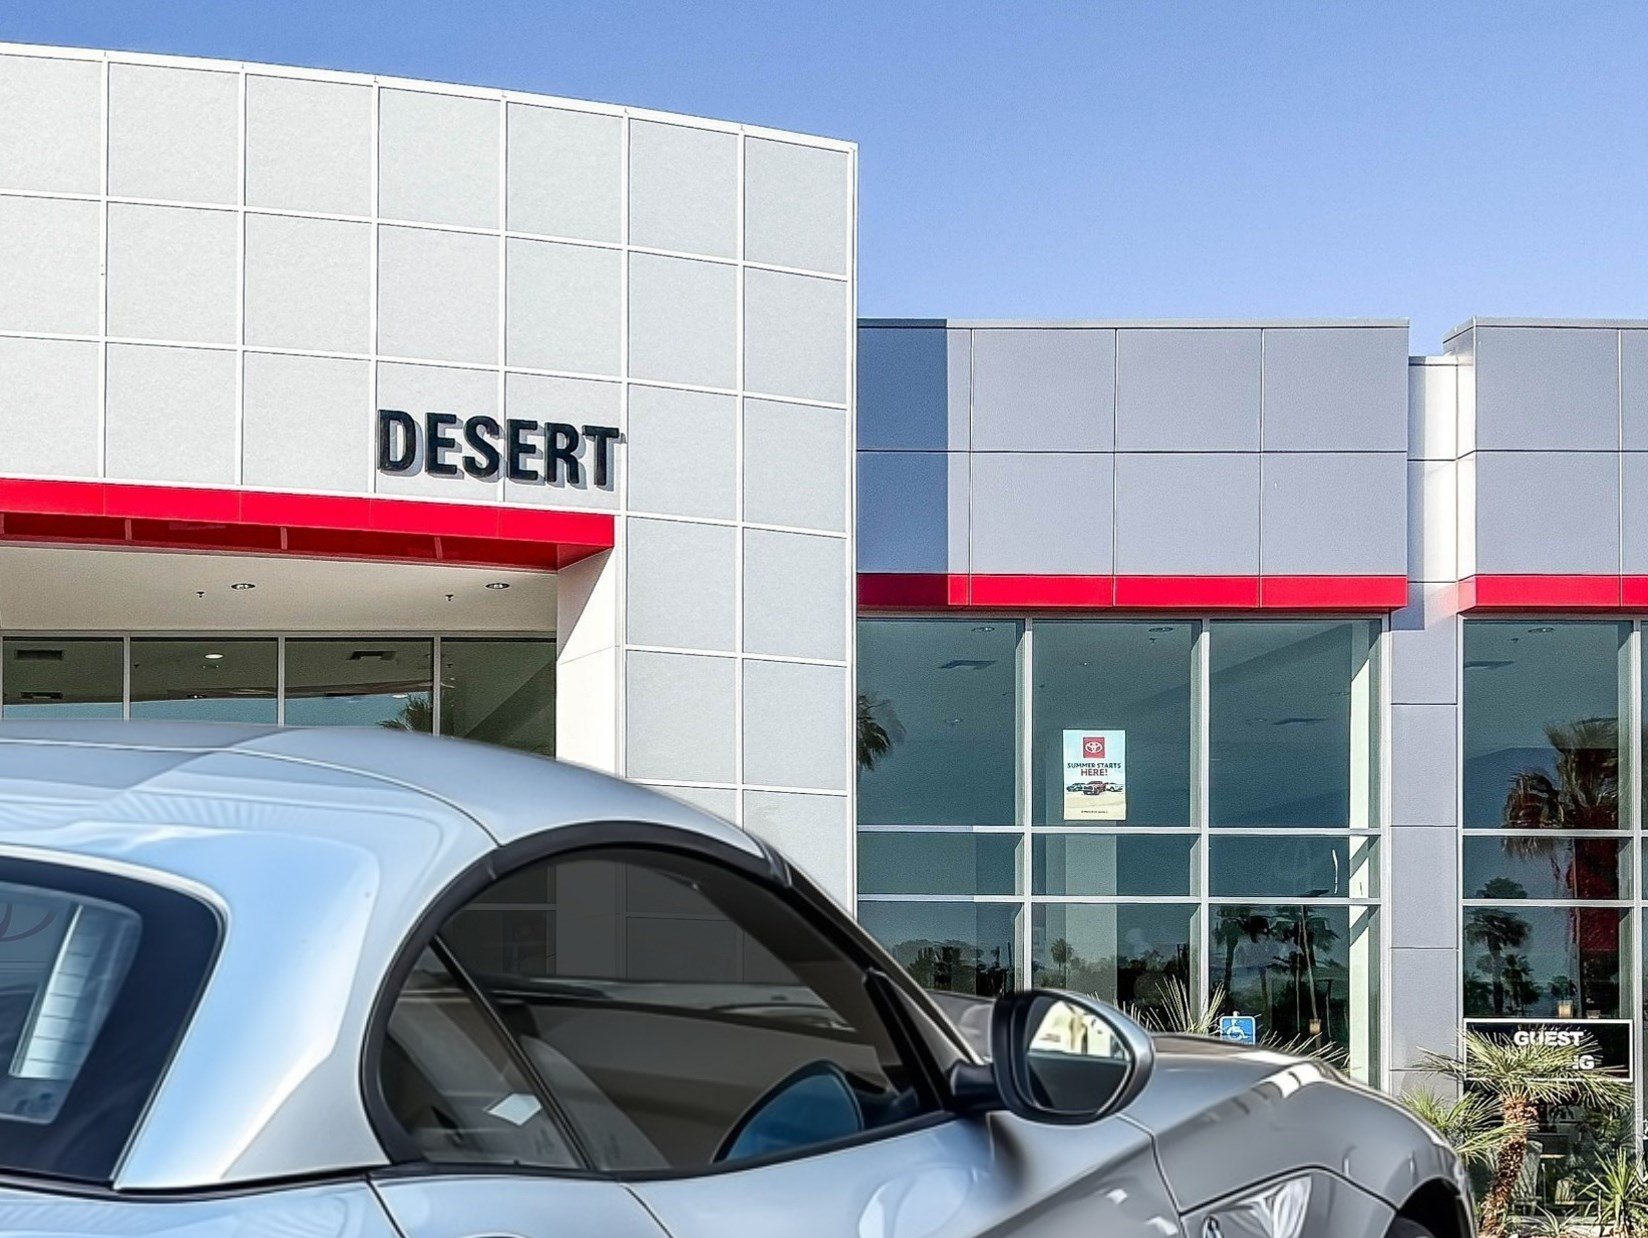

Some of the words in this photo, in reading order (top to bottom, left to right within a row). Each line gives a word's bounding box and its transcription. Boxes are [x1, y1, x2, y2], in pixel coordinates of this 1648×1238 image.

[378, 409, 619, 487] DESERT
[1080, 768, 1108, 777] HERE!
[1513, 1030, 1585, 1047] GUEST
